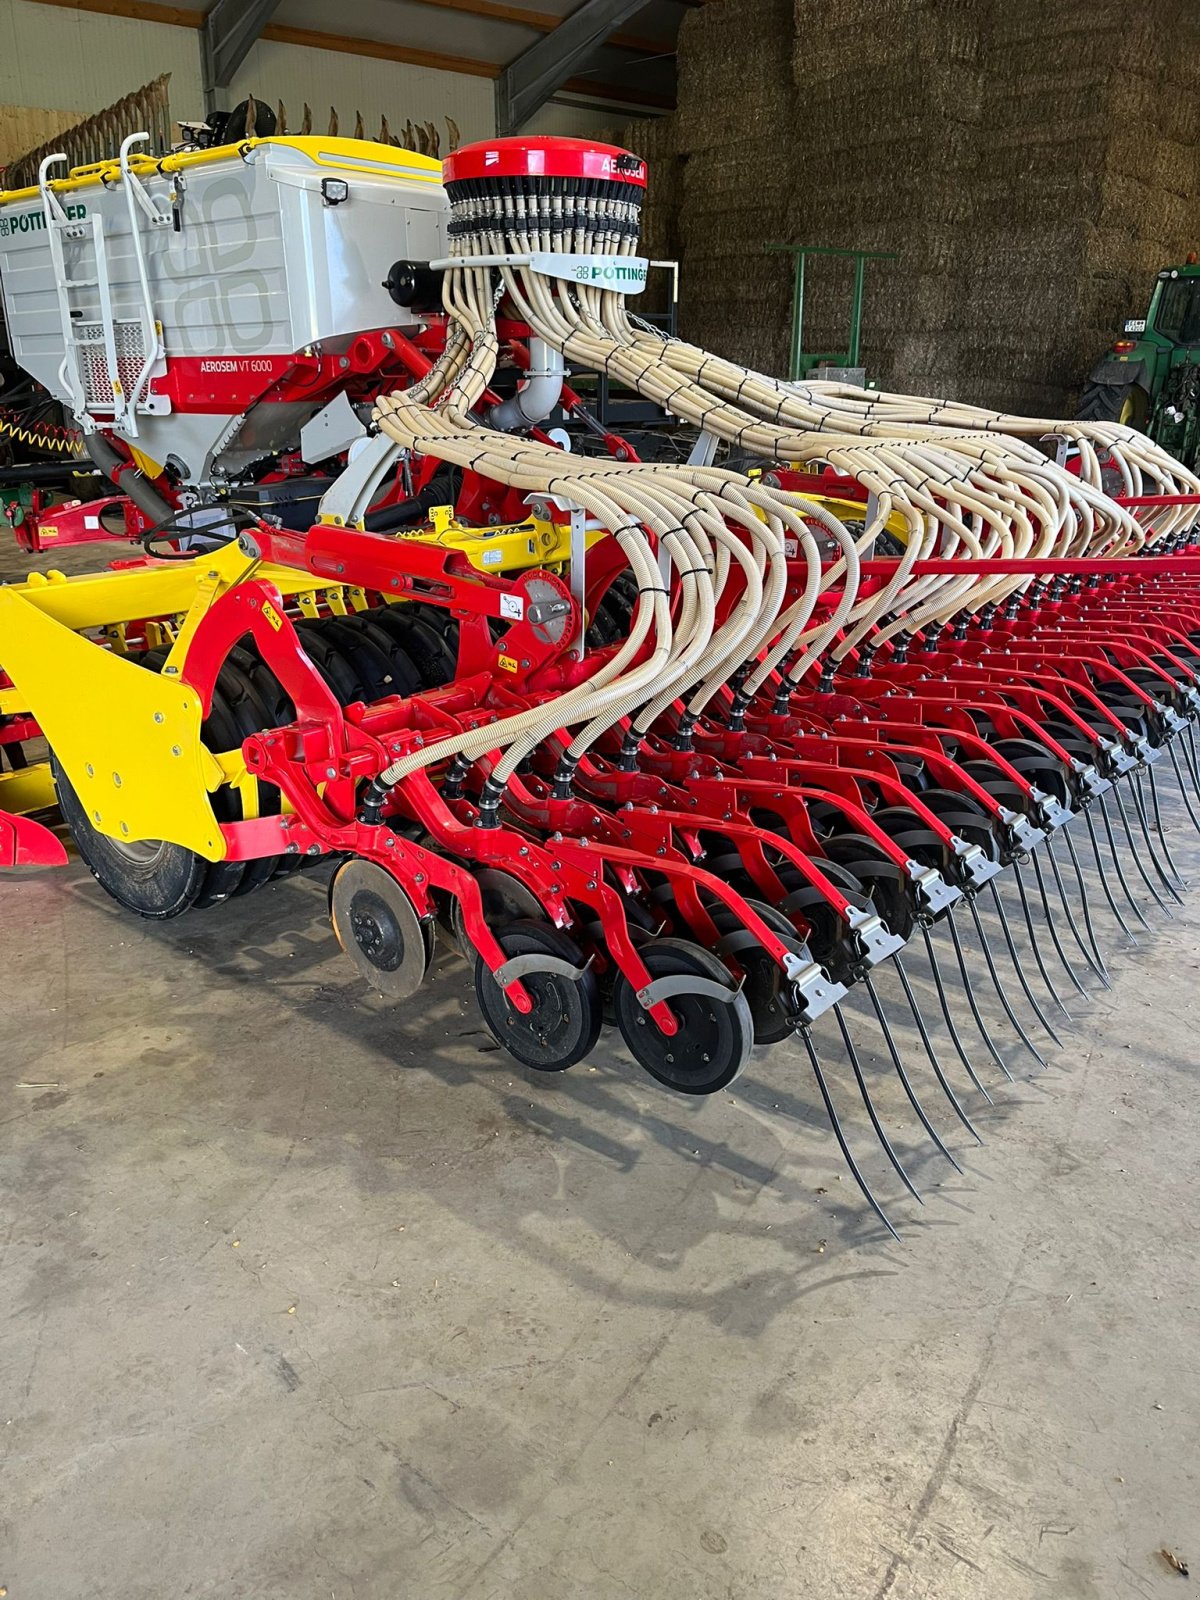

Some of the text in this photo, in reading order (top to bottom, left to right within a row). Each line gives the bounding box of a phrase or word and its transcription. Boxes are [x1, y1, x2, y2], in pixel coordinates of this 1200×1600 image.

[10, 204, 86, 234] PÖTTIER
[201, 360, 272, 372] AEROSEM VT 6000
